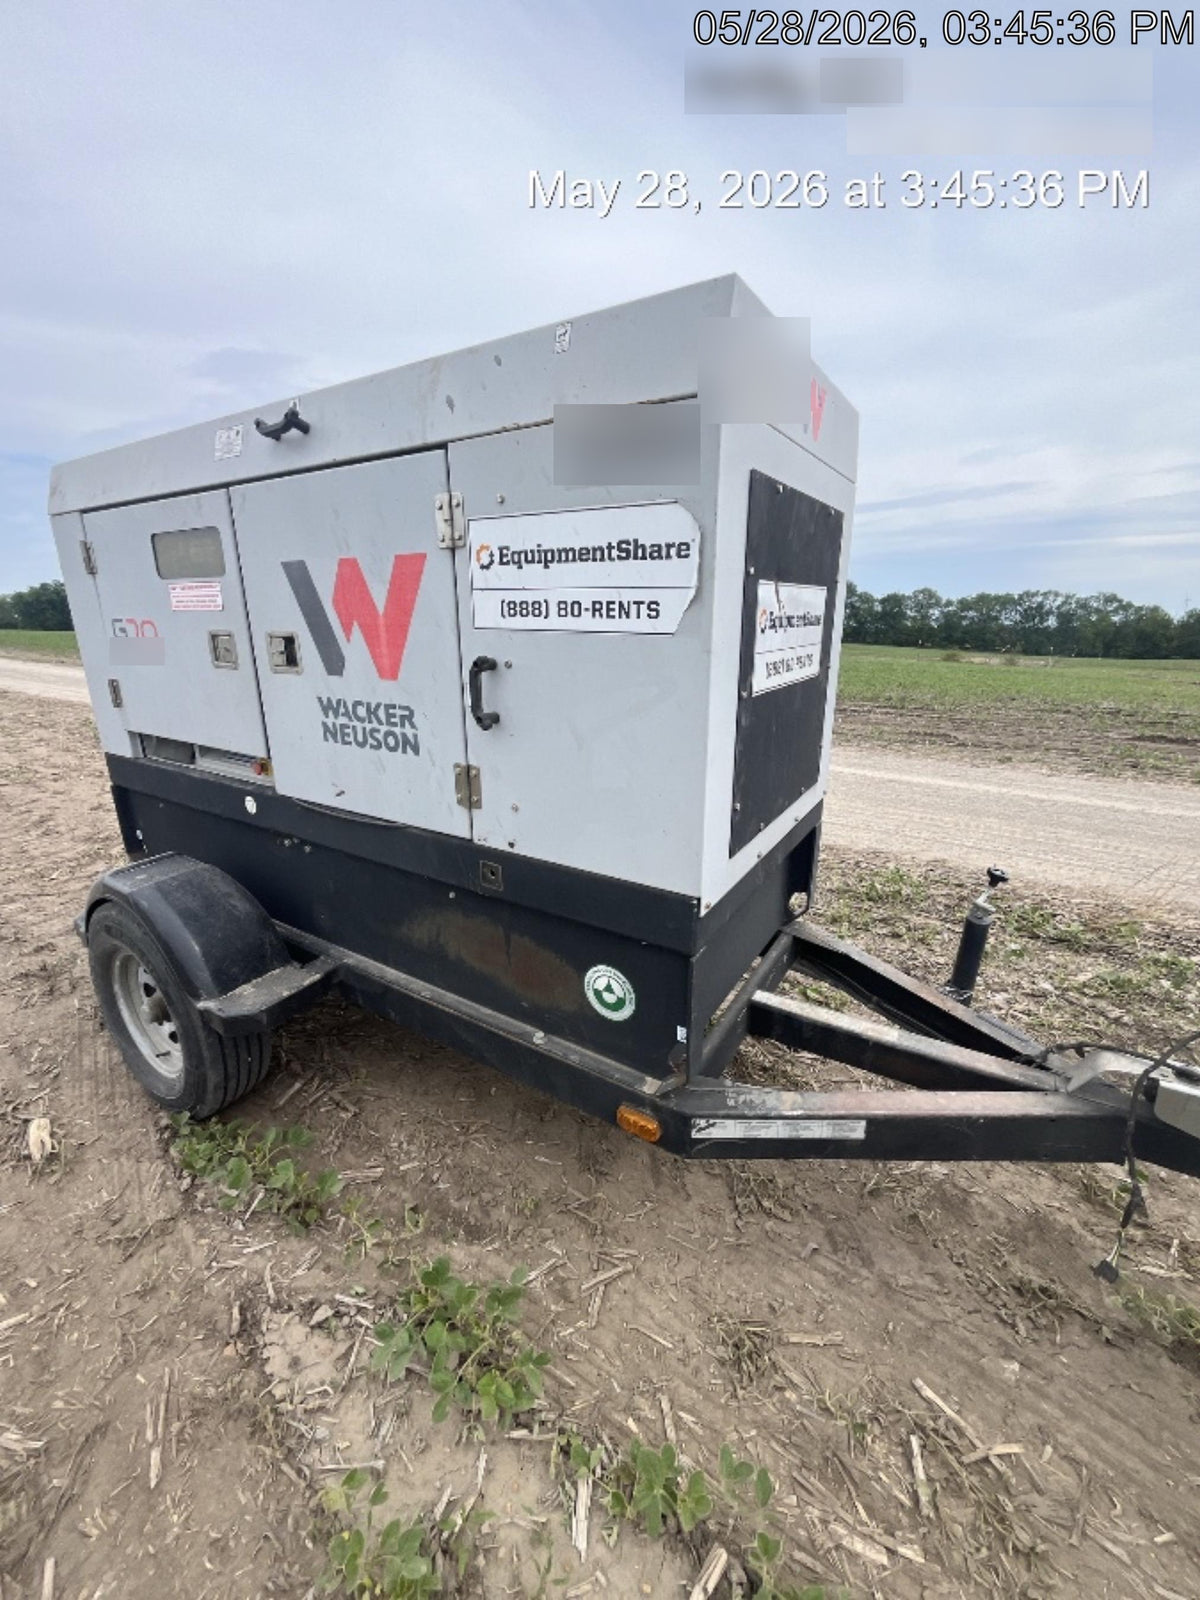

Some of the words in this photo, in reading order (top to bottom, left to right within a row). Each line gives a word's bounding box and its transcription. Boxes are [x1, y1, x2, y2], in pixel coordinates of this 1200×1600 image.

[497, 538, 691, 569] EquipmentShare
[500, 600, 549, 620] (888)
[316, 696, 418, 731] WACKER
[321, 720, 420, 757] NEUSON
